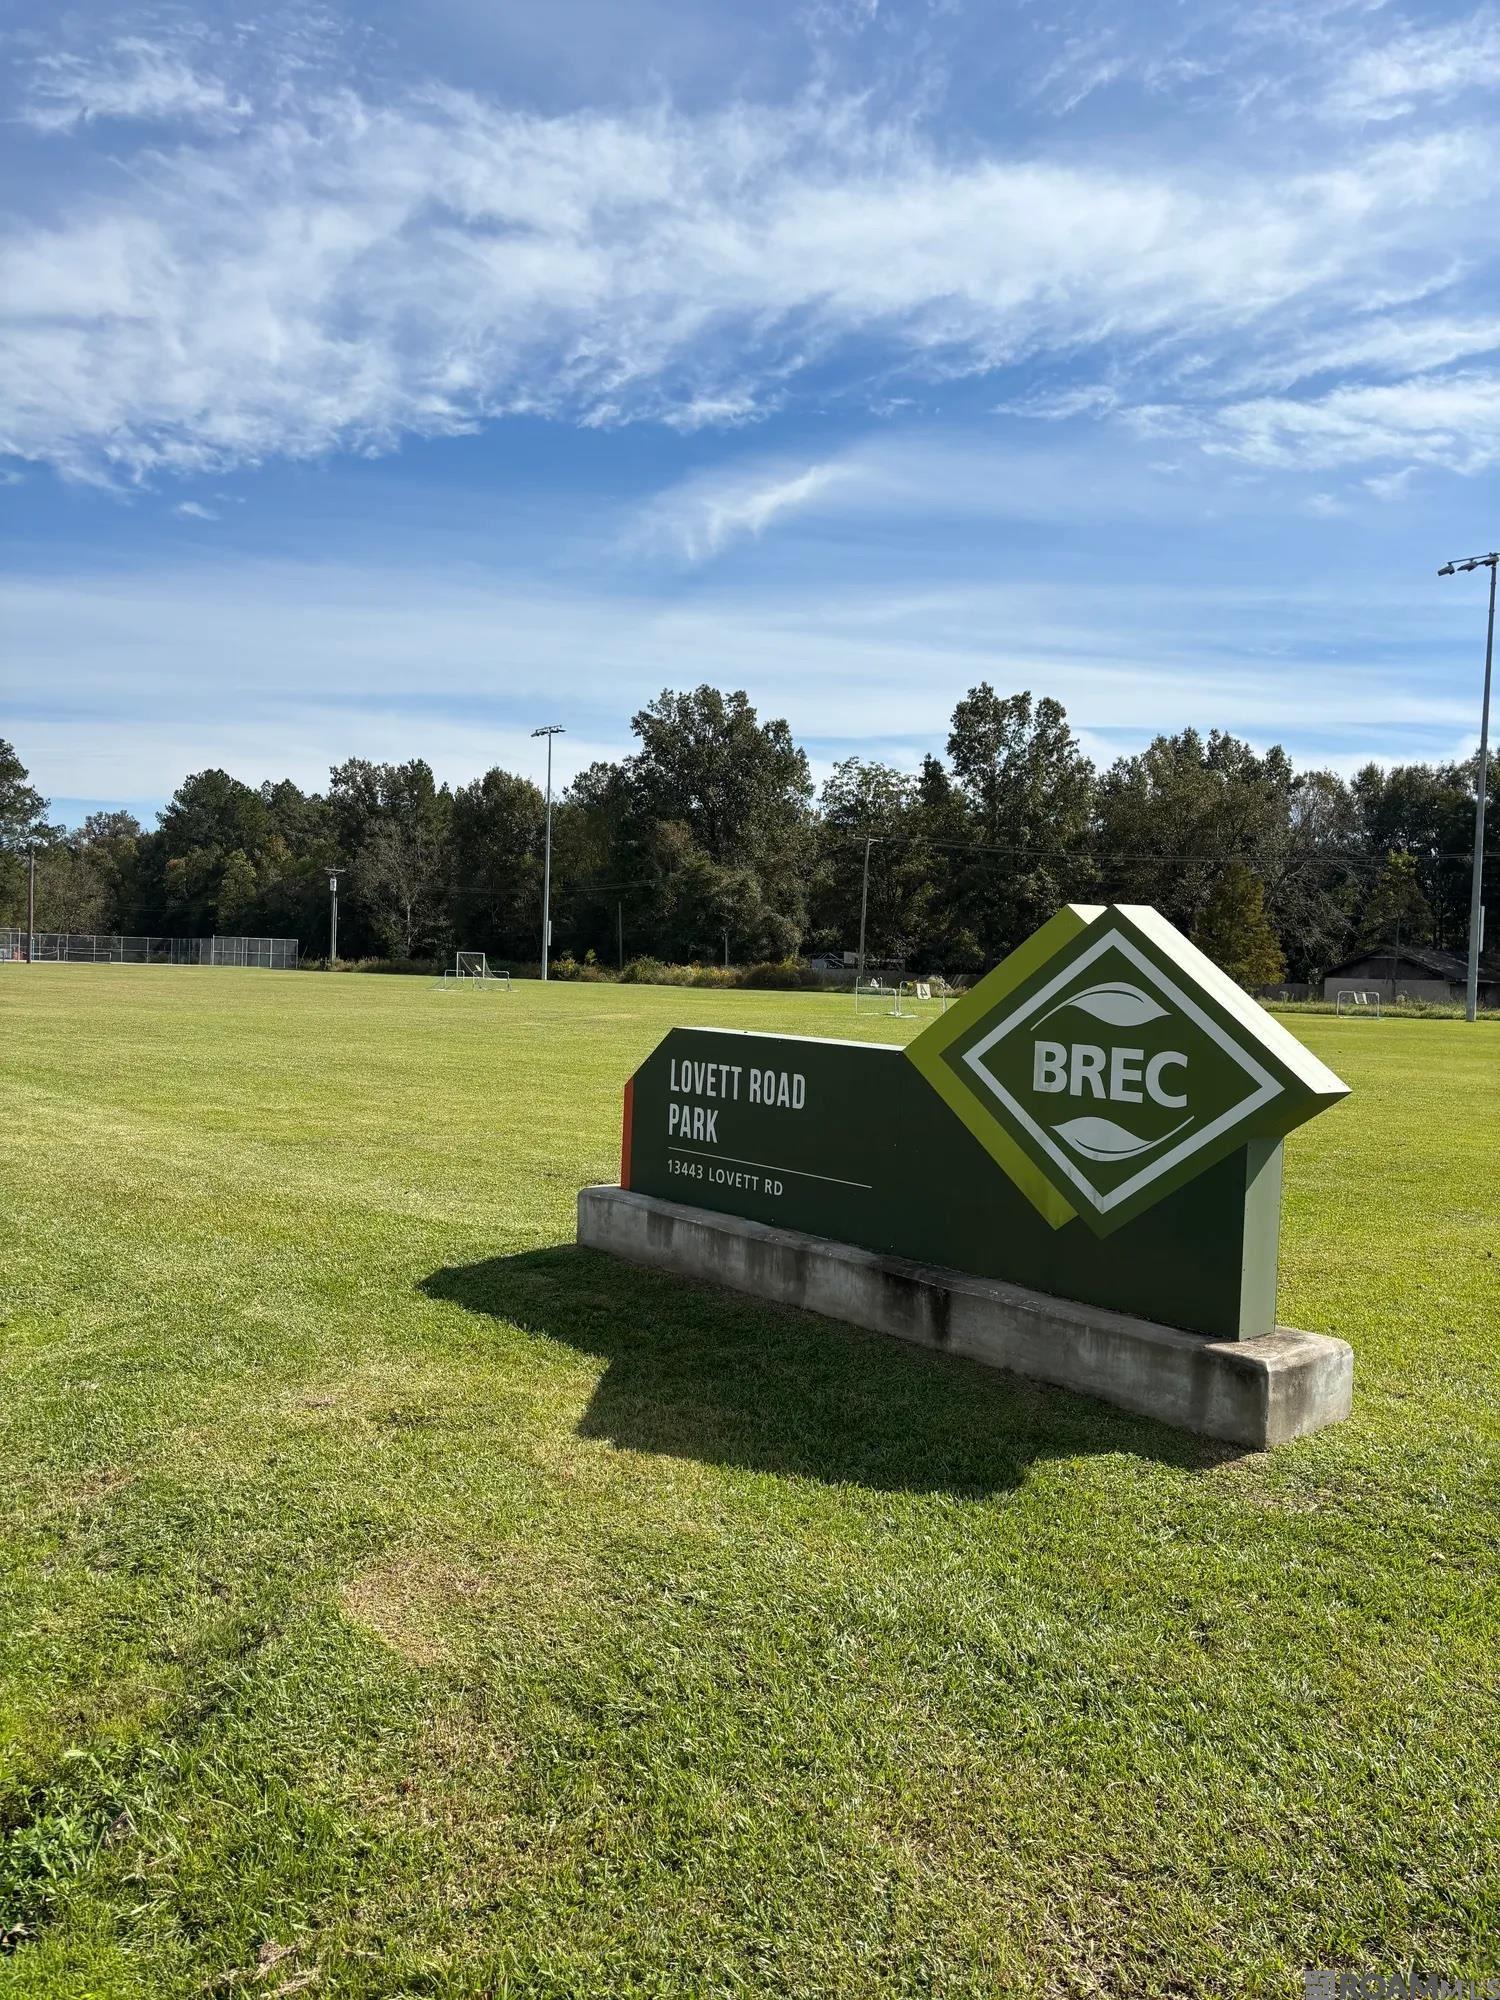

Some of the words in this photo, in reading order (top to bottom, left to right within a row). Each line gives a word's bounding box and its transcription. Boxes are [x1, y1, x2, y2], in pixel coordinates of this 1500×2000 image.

[669, 1058, 743, 1100] LOVETT
[749, 1068, 806, 1110] ROAD
[1032, 1040, 1189, 1109] BREC
[668, 1103, 719, 1144] PARK
[667, 1159, 703, 1179] 13443
[708, 1167, 760, 1191] LOVETT
[764, 1178, 783, 1196] RD
